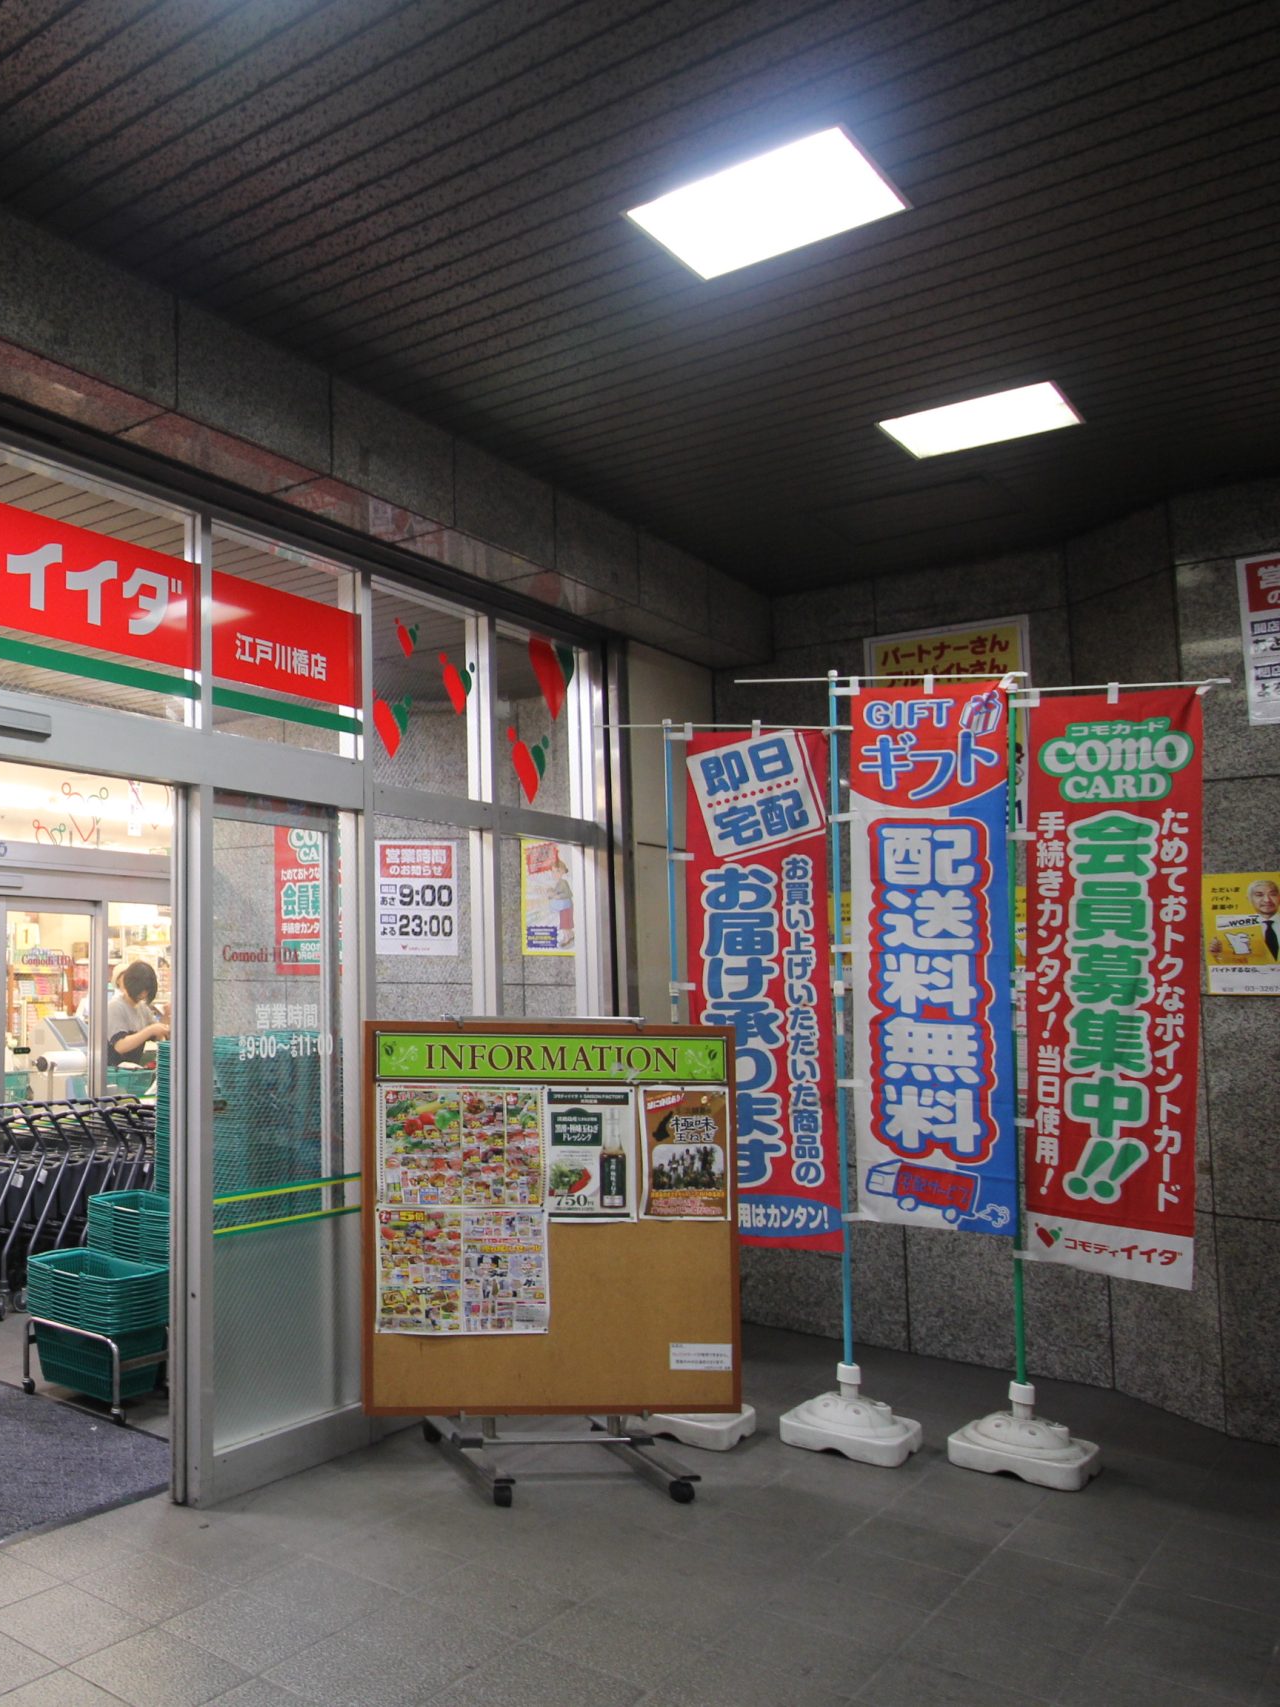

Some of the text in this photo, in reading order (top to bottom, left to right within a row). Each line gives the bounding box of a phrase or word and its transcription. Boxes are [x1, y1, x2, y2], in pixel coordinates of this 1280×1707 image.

[234, 631, 328, 682] 江戸川橋店
[881, 633, 1010, 667] パートナーさん
[864, 698, 954, 729] GIFT
[1070, 719, 1166, 737] コモカード
[699, 737, 795, 797] 即日
[859, 730, 998, 801] ギフト
[1064, 772, 1168, 800] CARD
[713, 789, 810, 847] 宅配
[398, 883, 453, 907] 9:00
[398, 914, 453, 938] 23:00
[882, 826, 982, 1153] 配送料無料
[1067, 812, 1157, 1201] 会員募集中!!
[255, 1003, 318, 1029] 営業時間
[784, 856, 823, 1185] お買い上げいただいた商品の
[1154, 807, 1190, 1213] ためておトクなポイントカード
[424, 1043, 679, 1074] INFORMATION
[1063, 1237, 1183, 1266] コモディイイダ
